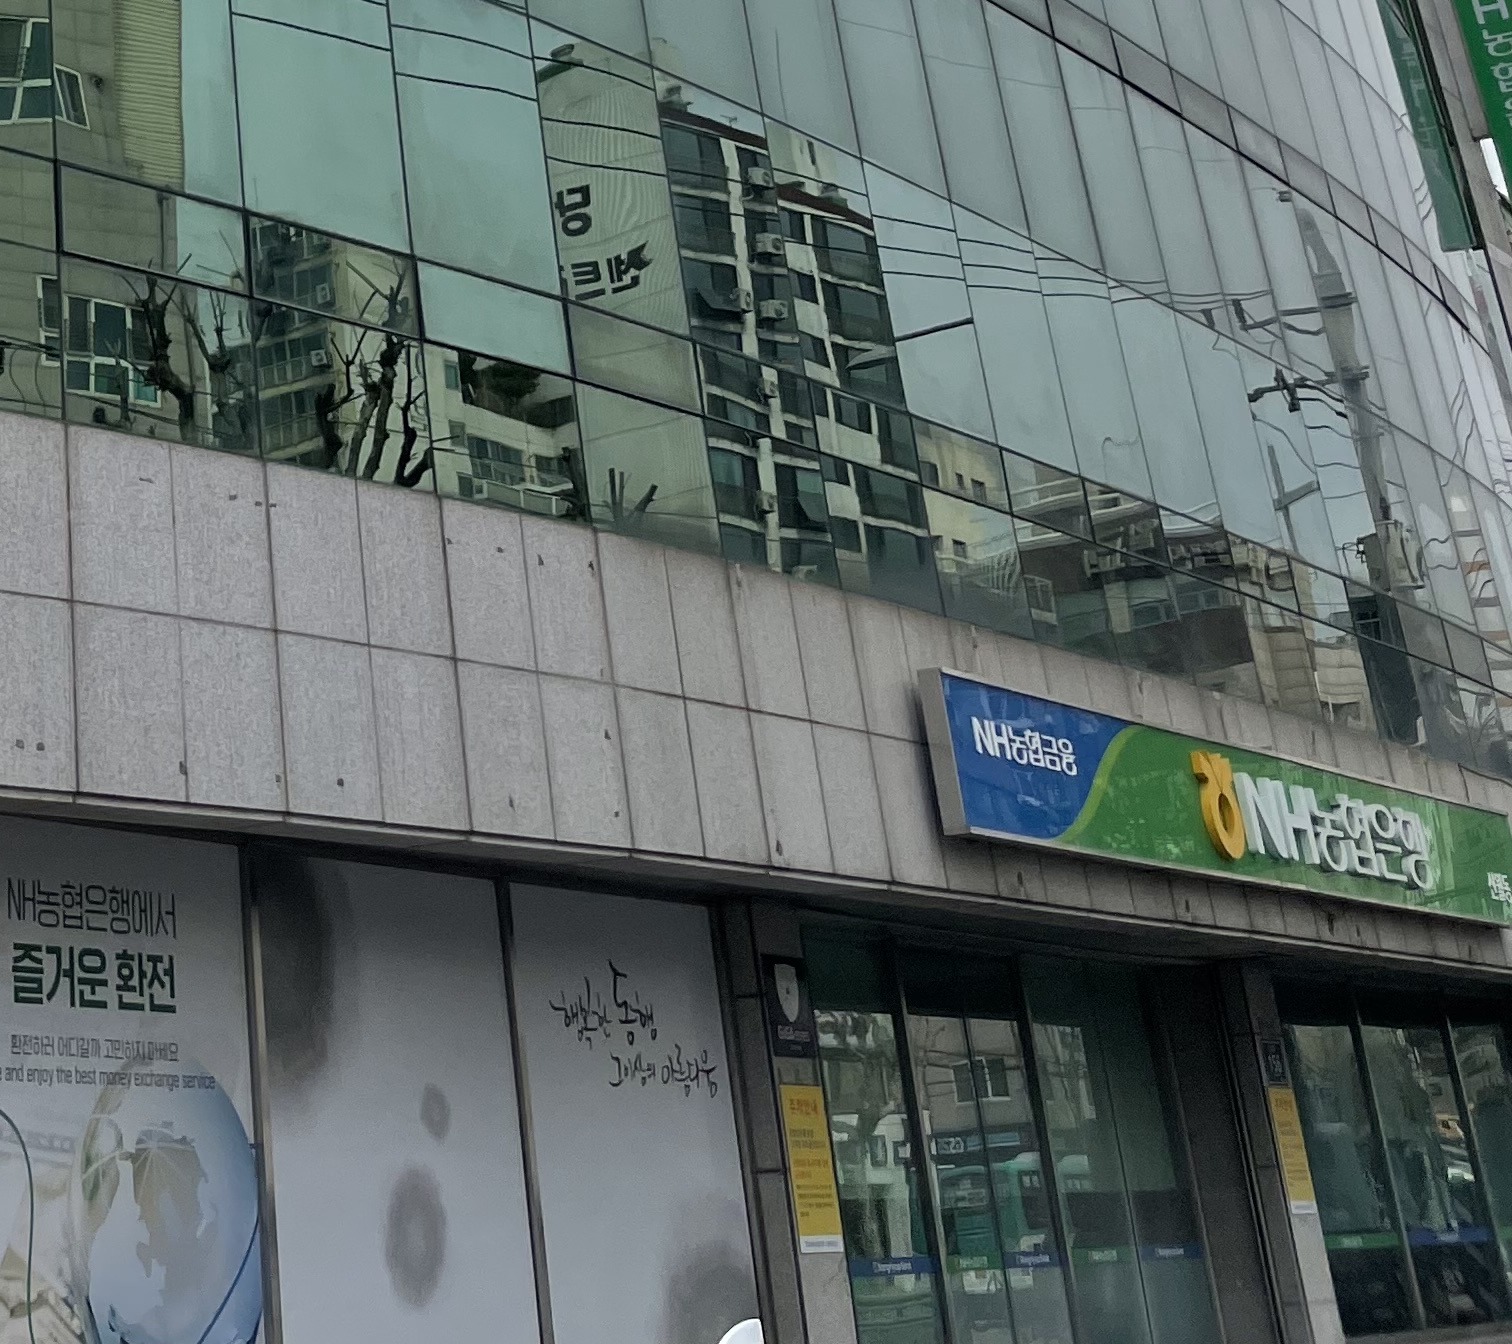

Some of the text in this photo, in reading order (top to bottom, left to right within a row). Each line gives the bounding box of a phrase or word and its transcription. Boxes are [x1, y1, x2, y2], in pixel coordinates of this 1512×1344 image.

[971, 716, 1078, 776] NH농협금융
[1233, 772, 1434, 890] NH농협은행
[7, 877, 177, 940] NH농협은행에서
[11, 942, 109, 1009] 즐거운
[115, 949, 177, 1014] 환전
[4, 1064, 25, 1082] and
[27, 1065, 54, 1087] enjoy
[56, 1067, 73, 1084] the
[75, 1067, 97, 1085] best
[99, 1070, 132, 1089] money
